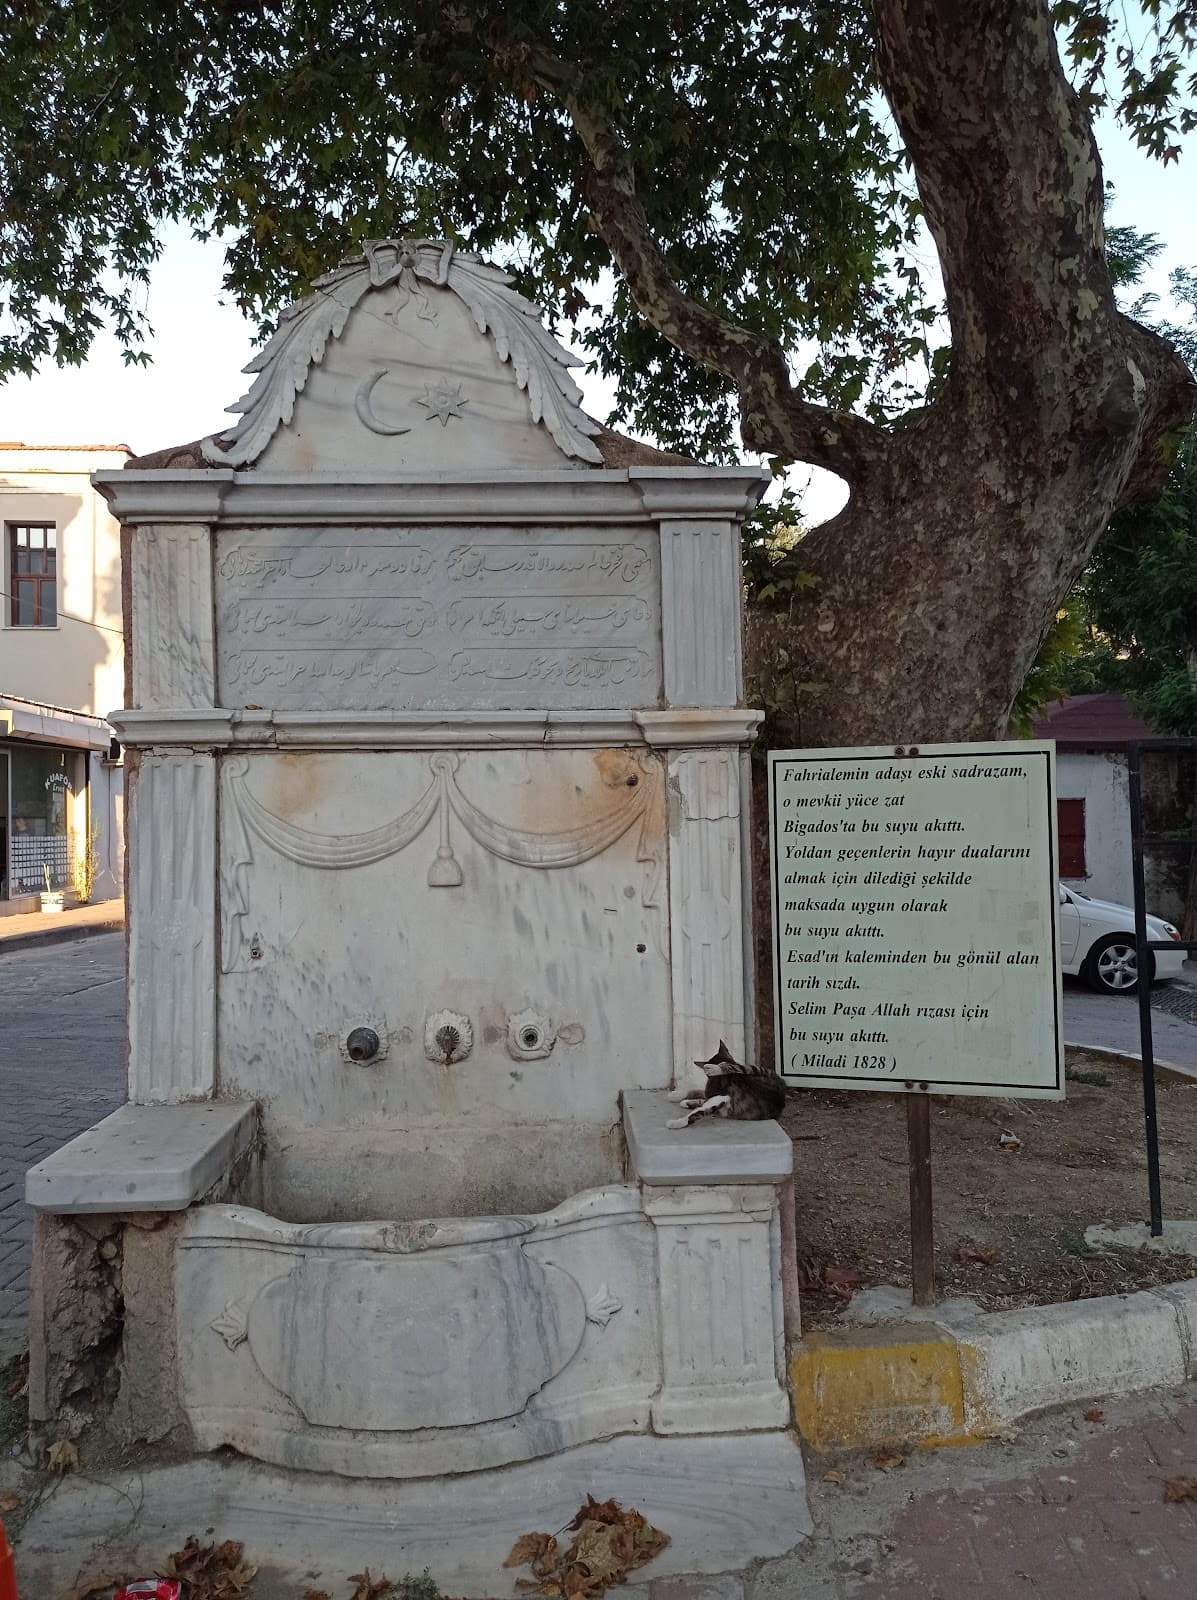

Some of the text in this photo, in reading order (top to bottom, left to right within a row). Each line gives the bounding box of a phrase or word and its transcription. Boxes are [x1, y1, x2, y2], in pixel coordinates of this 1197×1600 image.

[784, 764, 1028, 783] Fahrialemin adaşı eski sadrazam,
[783, 794, 906, 811] o mevkii yüce zat
[784, 819, 965, 836] Bigados'ta bu suyu akıttı.
[785, 844, 1031, 863] Yoldan geçenlerin hayır dualarını
[785, 872, 973, 889] almak için dilediği şekilde
[785, 898, 948, 916] maksada uygun olarak
[785, 923, 885, 940] bu suyu akıttı.
[787, 949, 1040, 968] Esad'ın kaleminden bu gönül alan
[788, 976, 861, 991] tarih sızdı.
[788, 1002, 989, 1023] Selim Paşa Allah rızası için
[790, 1028, 889, 1045] bu suyu akıttı.
[801, 1054, 848, 1069] Miladi
[853, 1056, 887, 1070] 1828
